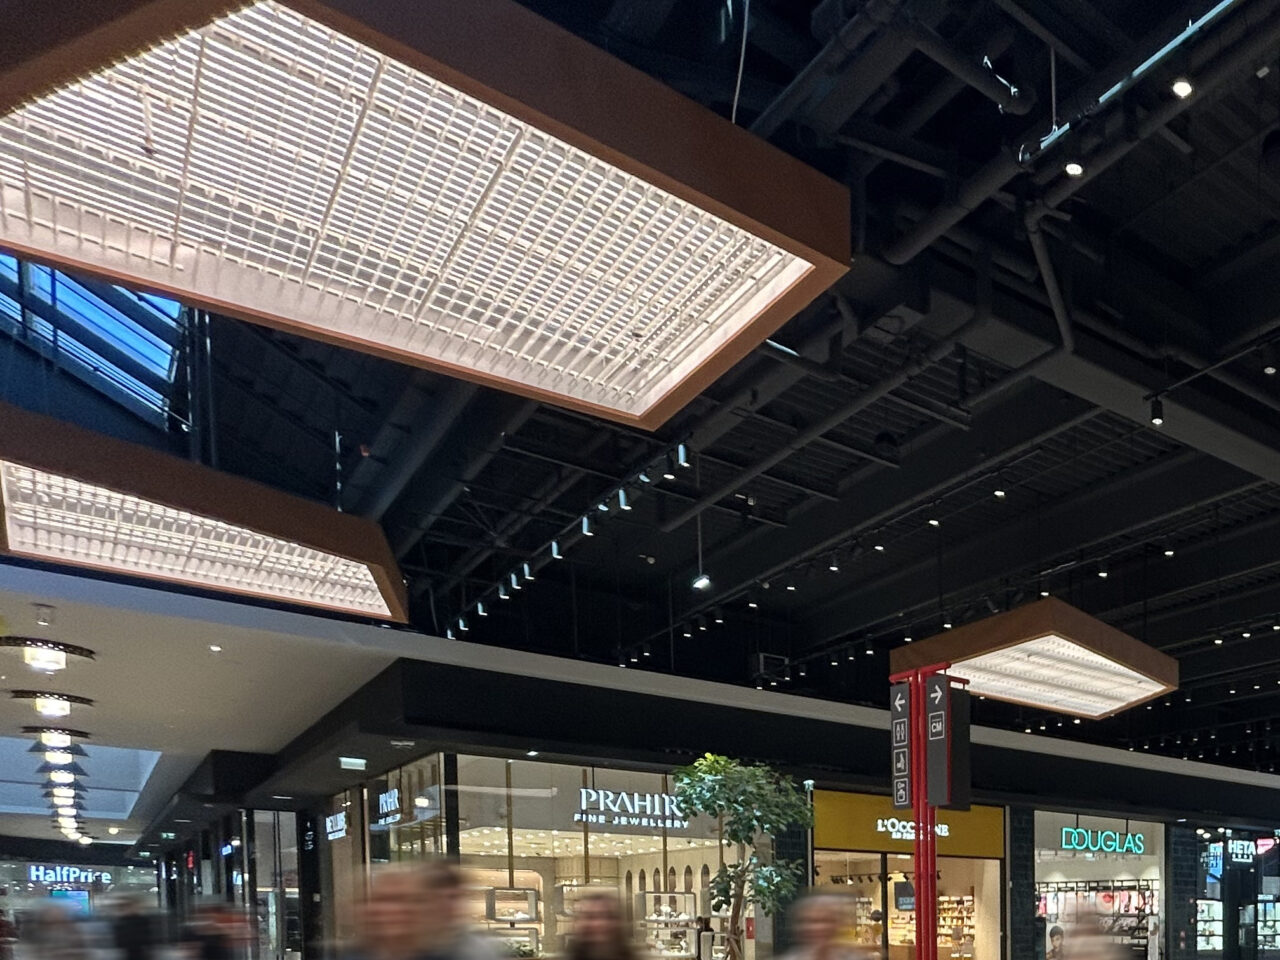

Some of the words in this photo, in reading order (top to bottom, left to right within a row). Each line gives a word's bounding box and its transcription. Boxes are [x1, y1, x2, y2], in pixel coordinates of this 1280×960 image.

[580, 788, 683, 817] PRAHIR
[574, 813, 606, 824] FINE
[613, 816, 689, 829] JEWELLERY
[1061, 827, 1144, 854] DOUGLAS
